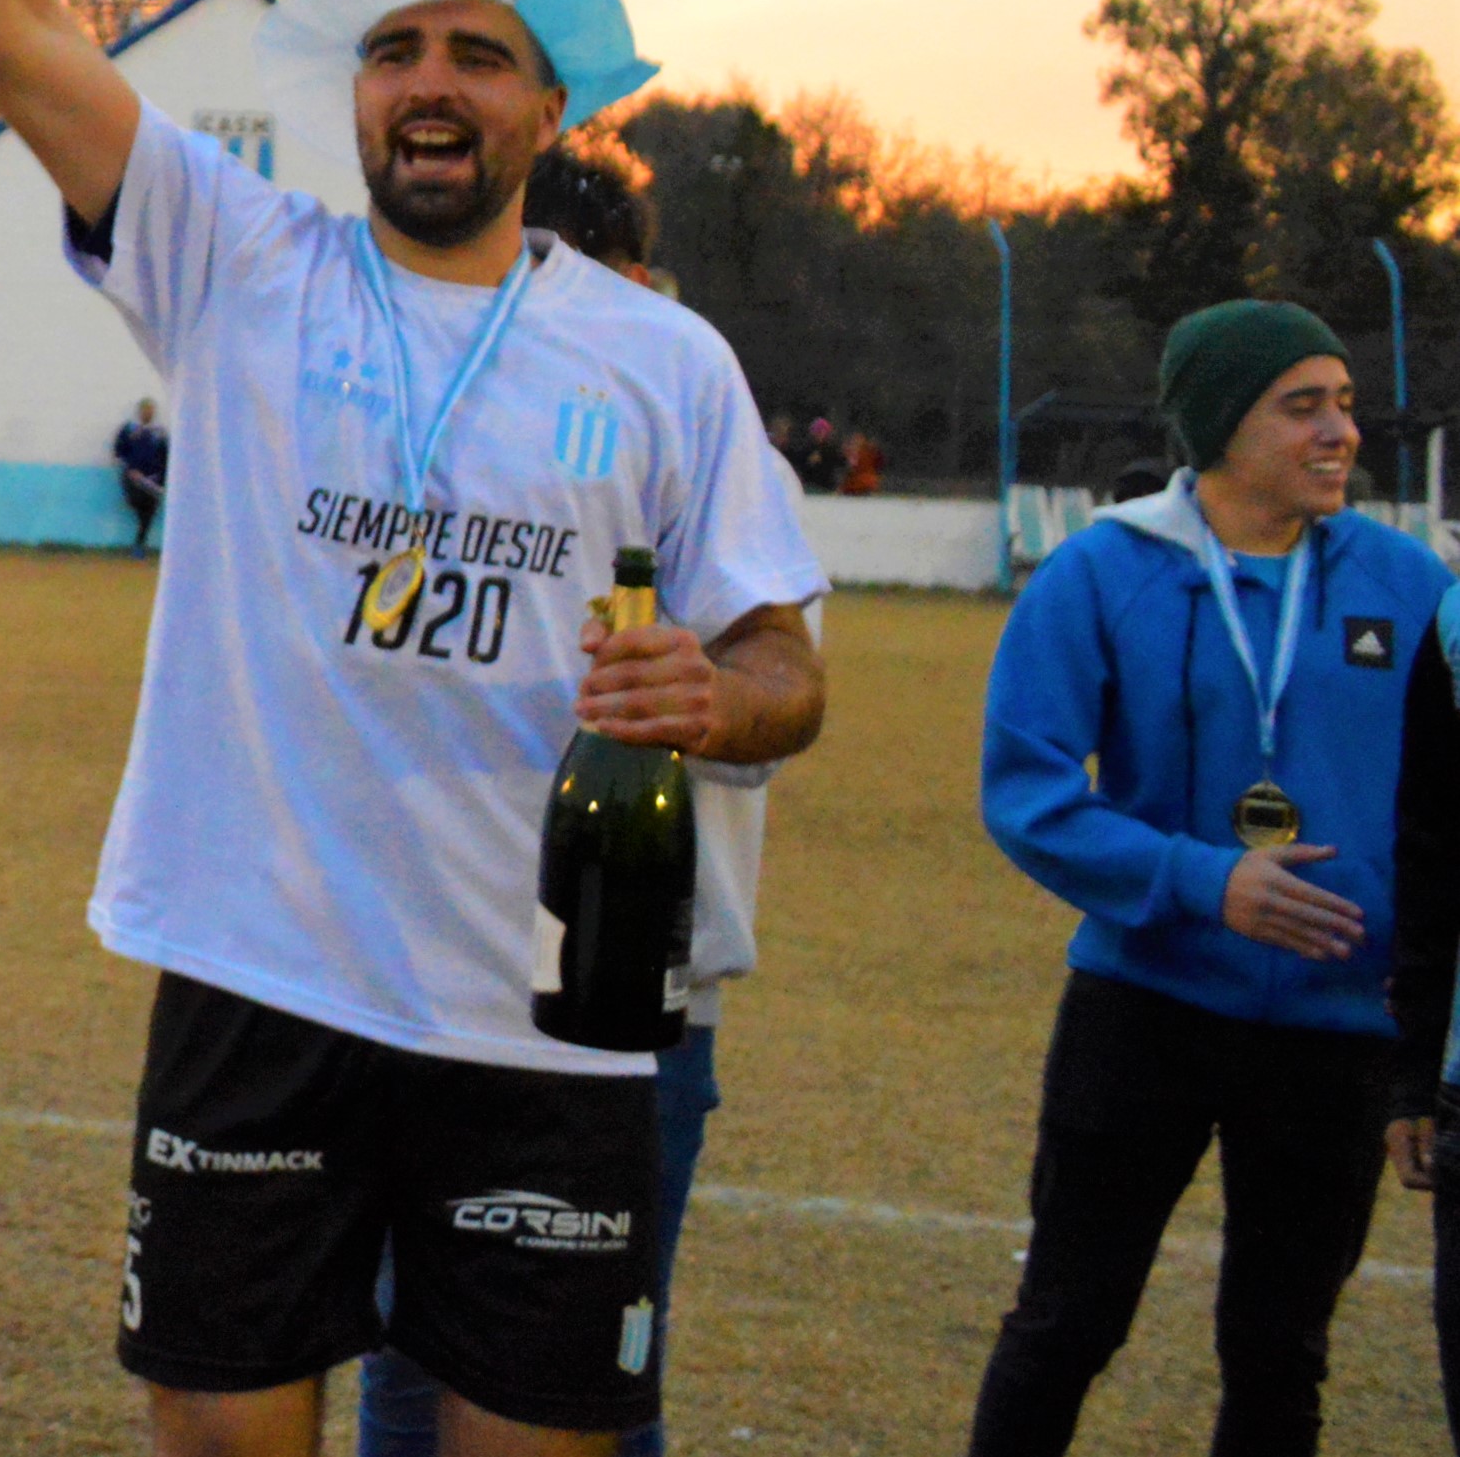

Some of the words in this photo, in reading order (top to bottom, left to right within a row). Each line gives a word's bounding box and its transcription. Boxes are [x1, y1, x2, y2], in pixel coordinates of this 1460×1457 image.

[460, 512, 579, 578] DESDE
[146, 1127, 324, 1173] EXTINMACK
[453, 1204, 632, 1238] CORSINI
